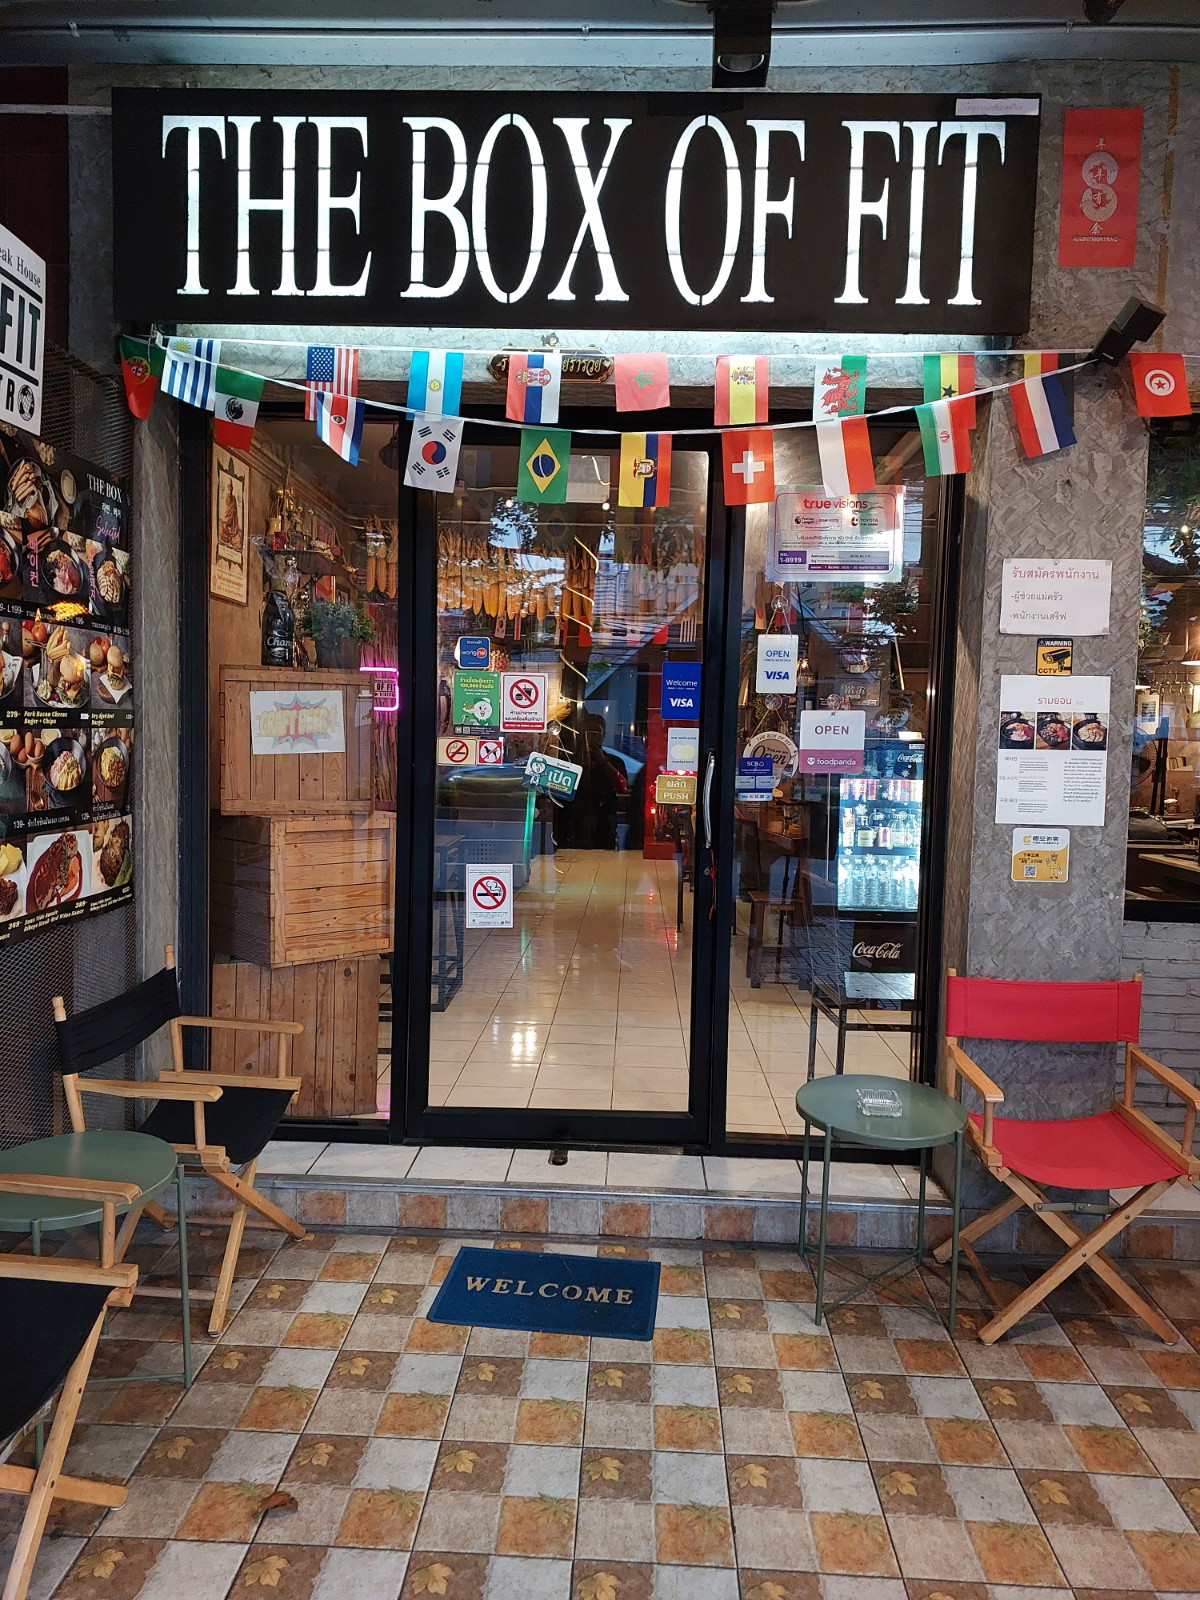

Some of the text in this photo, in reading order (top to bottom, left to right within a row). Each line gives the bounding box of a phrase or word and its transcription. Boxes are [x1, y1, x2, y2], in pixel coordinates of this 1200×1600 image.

[162, 113, 1006, 306] THE BOX OF FIT
[17, 255, 41, 288] House
[0, 283, 40, 371] FIT
[87, 473, 122, 503] THE BOX
[803, 498, 868, 509] true visions
[96, 515, 121, 542] Selected
[29, 538, 39, 587] 베이컨
[1012, 566, 1100, 579] รับสมัครพนักงาน
[1011, 590, 1063, 603] -ผู้ช่วยแม่ครัว
[764, 671, 790, 680] VISA
[666, 679, 698, 687] Welcome
[669, 698, 694, 707] VISA
[1038, 697, 1072, 705] รามยอน
[259, 709, 298, 737] CRAFT
[815, 726, 849, 734] OPEN
[817, 758, 857, 766] foodpanda
[897, 754, 924, 763] Coca-Cola
[548, 769, 572, 787] เปิด
[667, 778, 687, 788] ผลัก
[664, 792, 689, 800] PUSH
[852, 942, 904, 959] Coca-Cola
[466, 1276, 634, 1305] WELCOME
